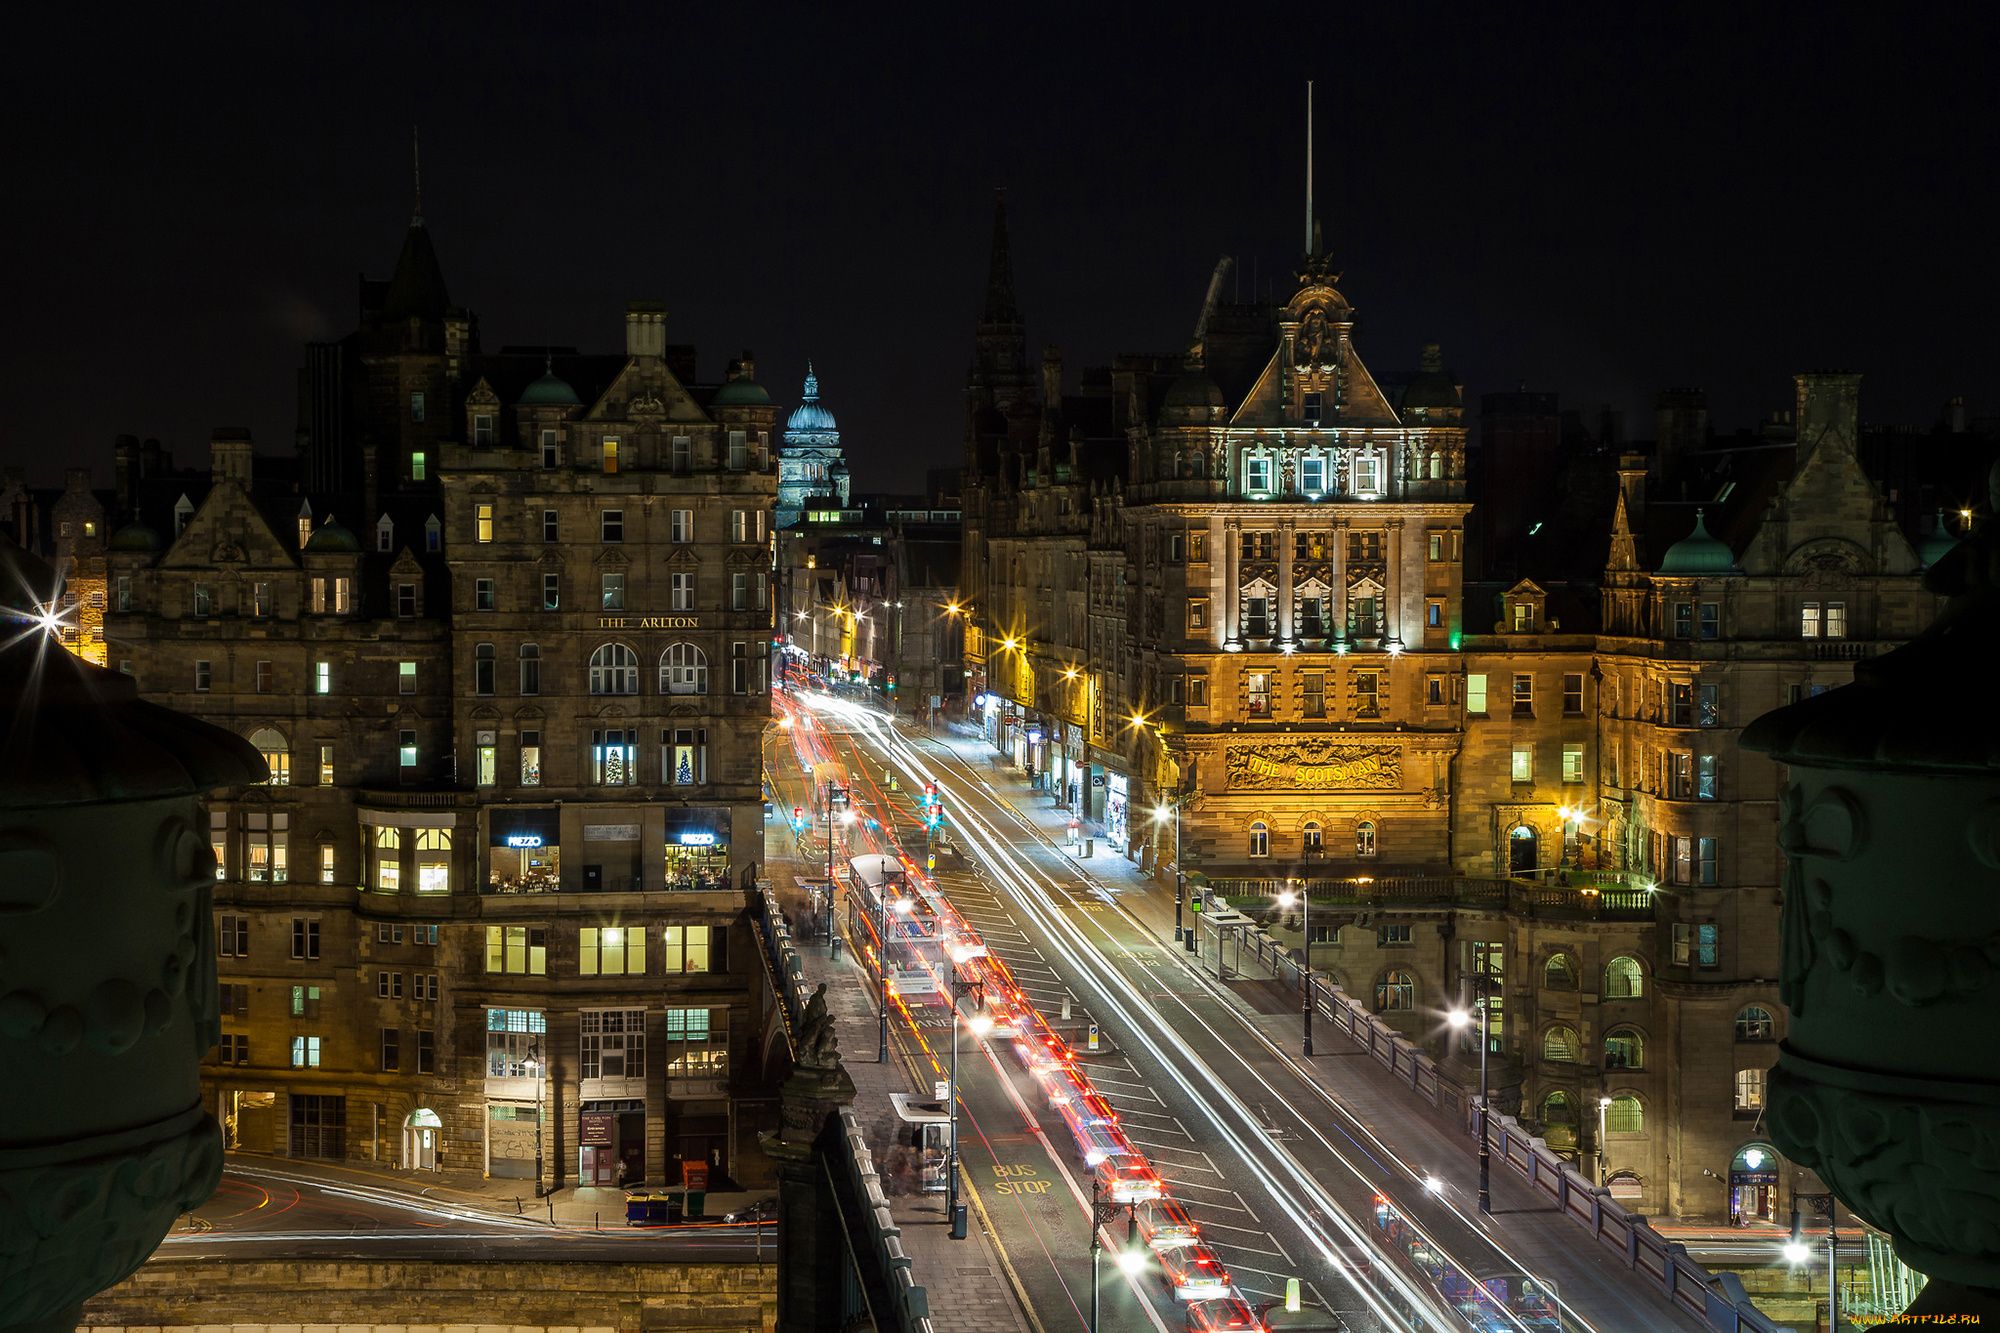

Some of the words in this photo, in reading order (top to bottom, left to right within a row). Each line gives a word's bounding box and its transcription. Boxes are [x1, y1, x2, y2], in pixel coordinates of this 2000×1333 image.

[598, 617, 626, 628] THE
[640, 617, 699, 628] ARLTON
[1251, 757, 1281, 778] THE
[1295, 756, 1381, 782] SCOTSMAN
[508, 836, 542, 847] PREZZO
[991, 1164, 1037, 1178] BUS
[994, 1180, 1052, 1195] STOP
